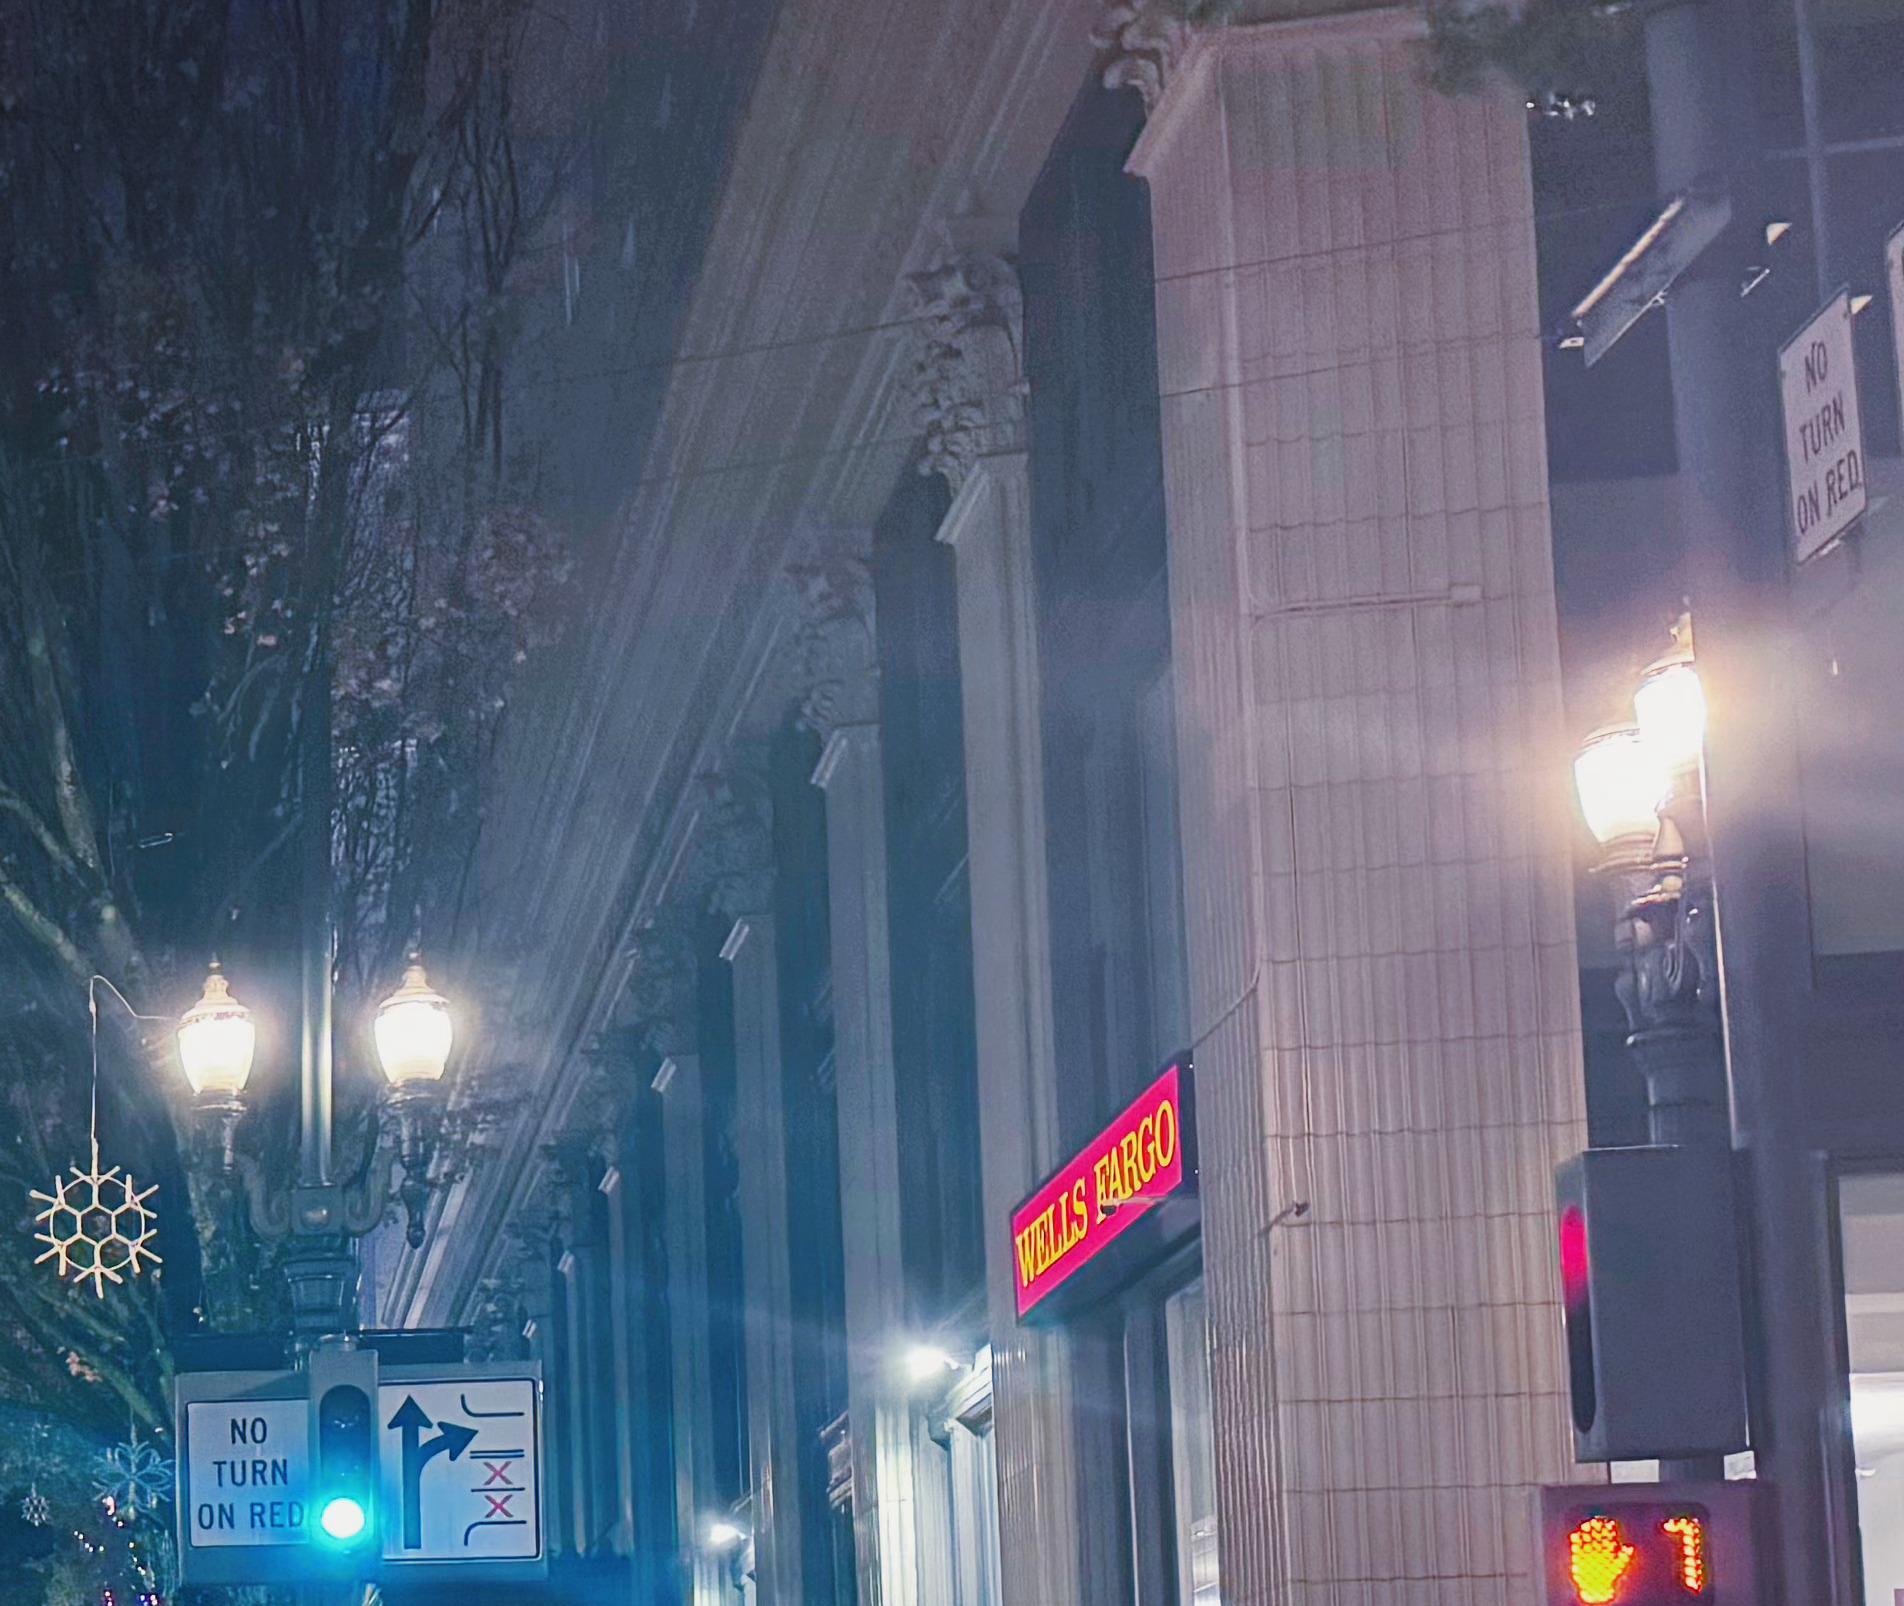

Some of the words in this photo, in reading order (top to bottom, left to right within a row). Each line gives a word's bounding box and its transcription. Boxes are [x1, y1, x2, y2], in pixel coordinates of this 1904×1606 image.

[1804, 339, 1829, 393] NO
[1798, 390, 1847, 463] TURN
[1796, 479, 1821, 535] ON
[1826, 449, 1861, 514] RED
[1015, 1175, 1089, 1287] WELLS
[1094, 1099, 1175, 1223] FARGO
[230, 1416, 269, 1445] NO
[212, 1459, 289, 1487] TURN
[197, 1502, 236, 1530] ON
[249, 1501, 305, 1529] RED
